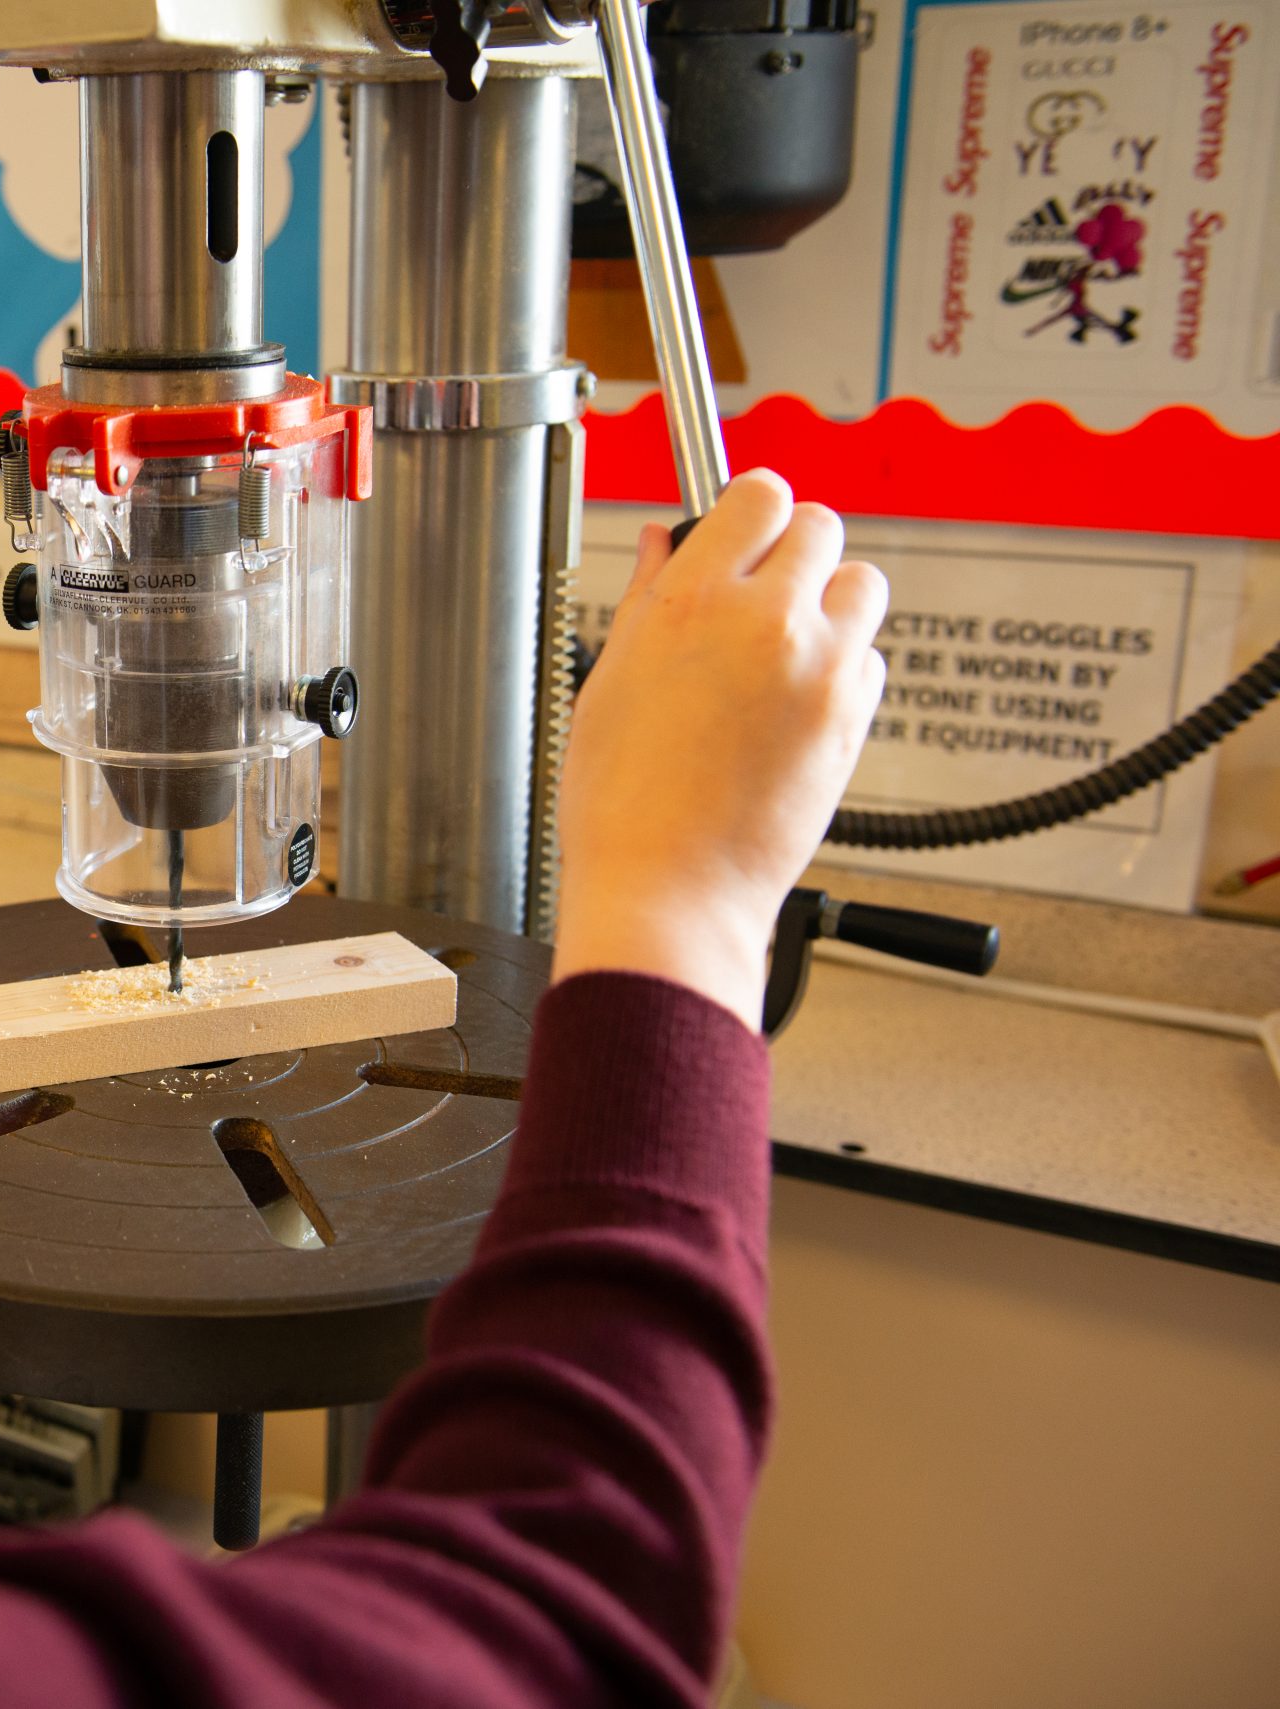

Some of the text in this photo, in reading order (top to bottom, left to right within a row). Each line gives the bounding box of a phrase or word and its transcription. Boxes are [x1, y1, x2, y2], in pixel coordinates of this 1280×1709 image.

[1131, 14, 1168, 42] 8+
[1022, 56, 1116, 81] GUCCI
[944, 45, 991, 198] Supreme
[1195, 21, 1250, 181] Supreme
[928, 212, 973, 358] Supreme
[1172, 207, 1225, 362] Supreme
[50, 566, 197, 590] A CLEERVUE GUARD
[883, 611, 1155, 656] CTIVE GOGGLES
[904, 650, 946, 676] BE
[956, 652, 1062, 684] WORN
[1071, 661, 1118, 690] BY
[991, 691, 1103, 727] USING
[917, 719, 1117, 762] EQUIPMENT
